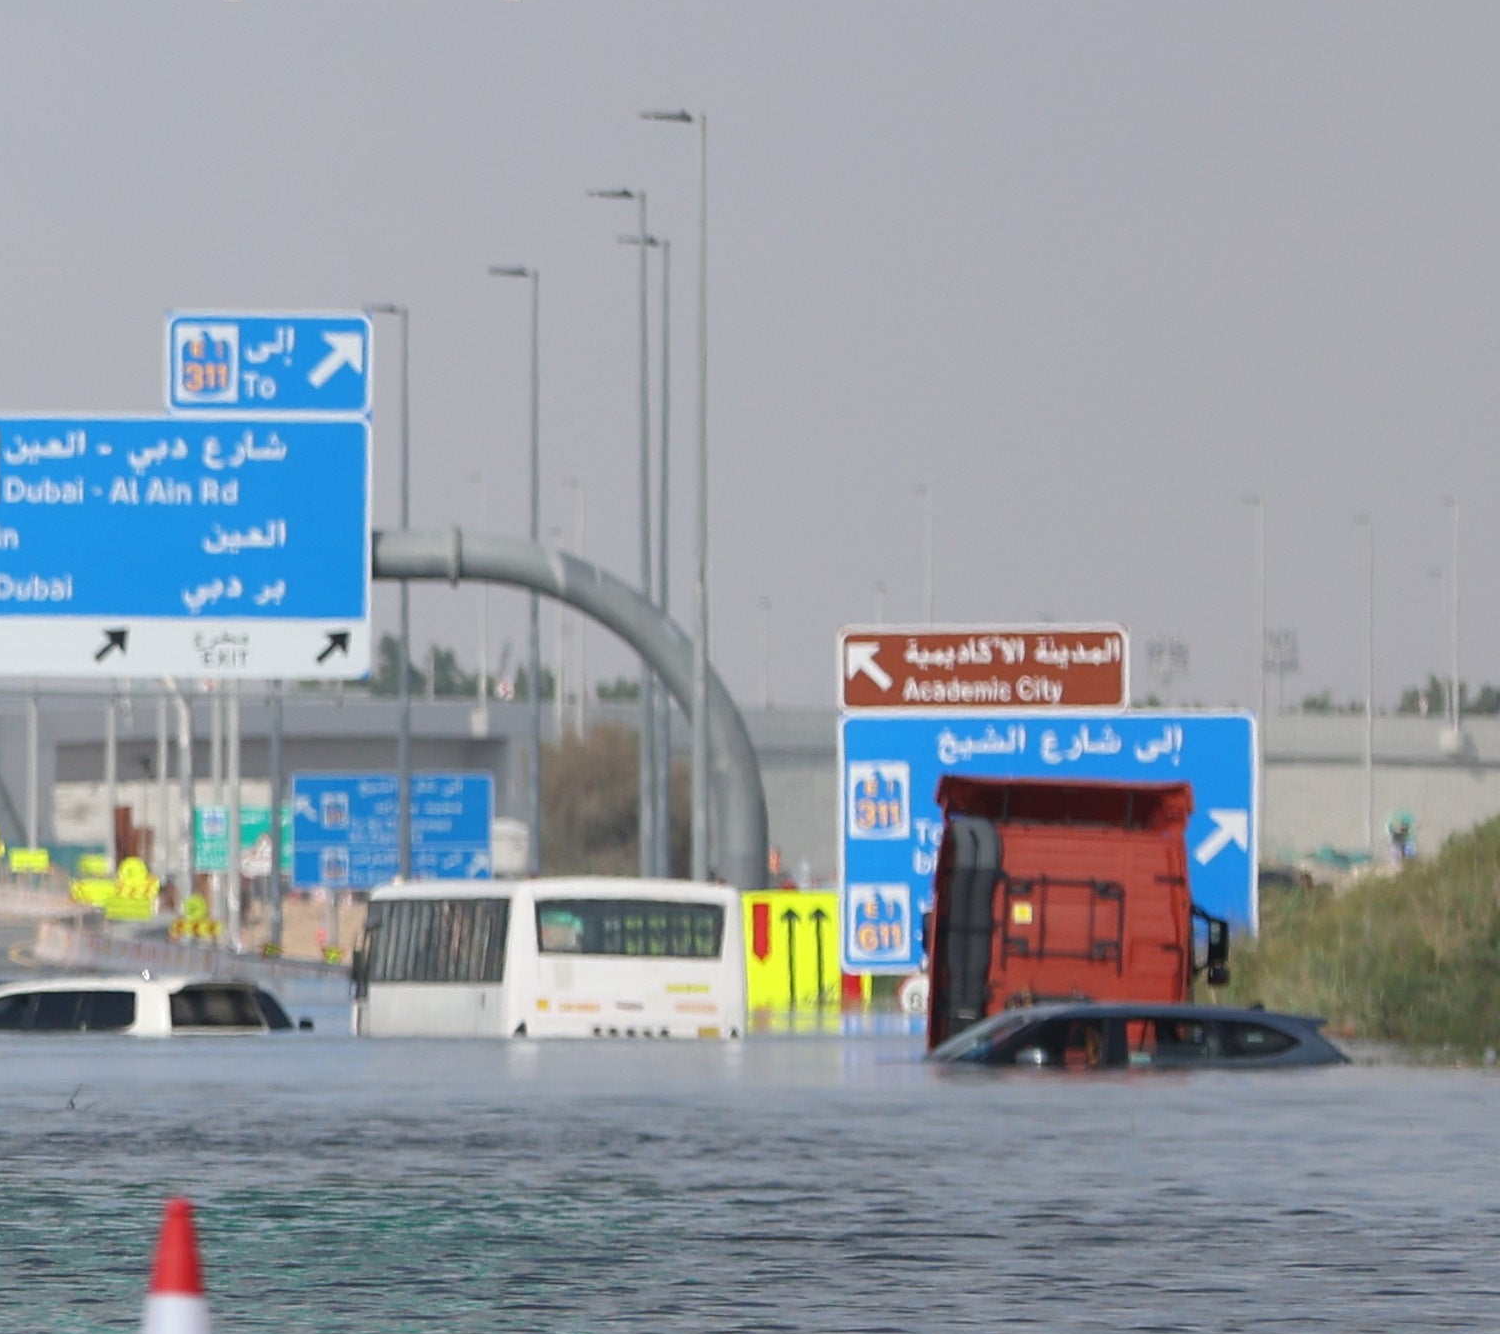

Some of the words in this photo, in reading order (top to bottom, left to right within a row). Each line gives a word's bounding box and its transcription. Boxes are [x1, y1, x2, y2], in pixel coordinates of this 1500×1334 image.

[246, 327, 294, 364] إلى
[182, 364, 228, 393] 311
[244, 372, 276, 398] To
[4, 432, 86, 464] العين
[129, 439, 187, 474] دبي
[203, 432, 287, 469] شارع
[3, 477, 83, 503] Dubai
[111, 478, 138, 503] Al
[147, 478, 192, 503] Ain
[201, 479, 238, 503] Rd
[204, 521, 286, 553] العين
[183, 578, 242, 612] دبي
[256, 581, 285, 604] بر
[1035, 634, 1122, 668] المدينة
[904, 678, 1011, 701] Academic
[1016, 675, 1062, 703] City
[939, 727, 1026, 764] الشيخ
[1042, 727, 1121, 763] شارع
[1136, 727, 1182, 764] إلى
[855, 800, 900, 829] 311
[858, 925, 902, 951] 611
